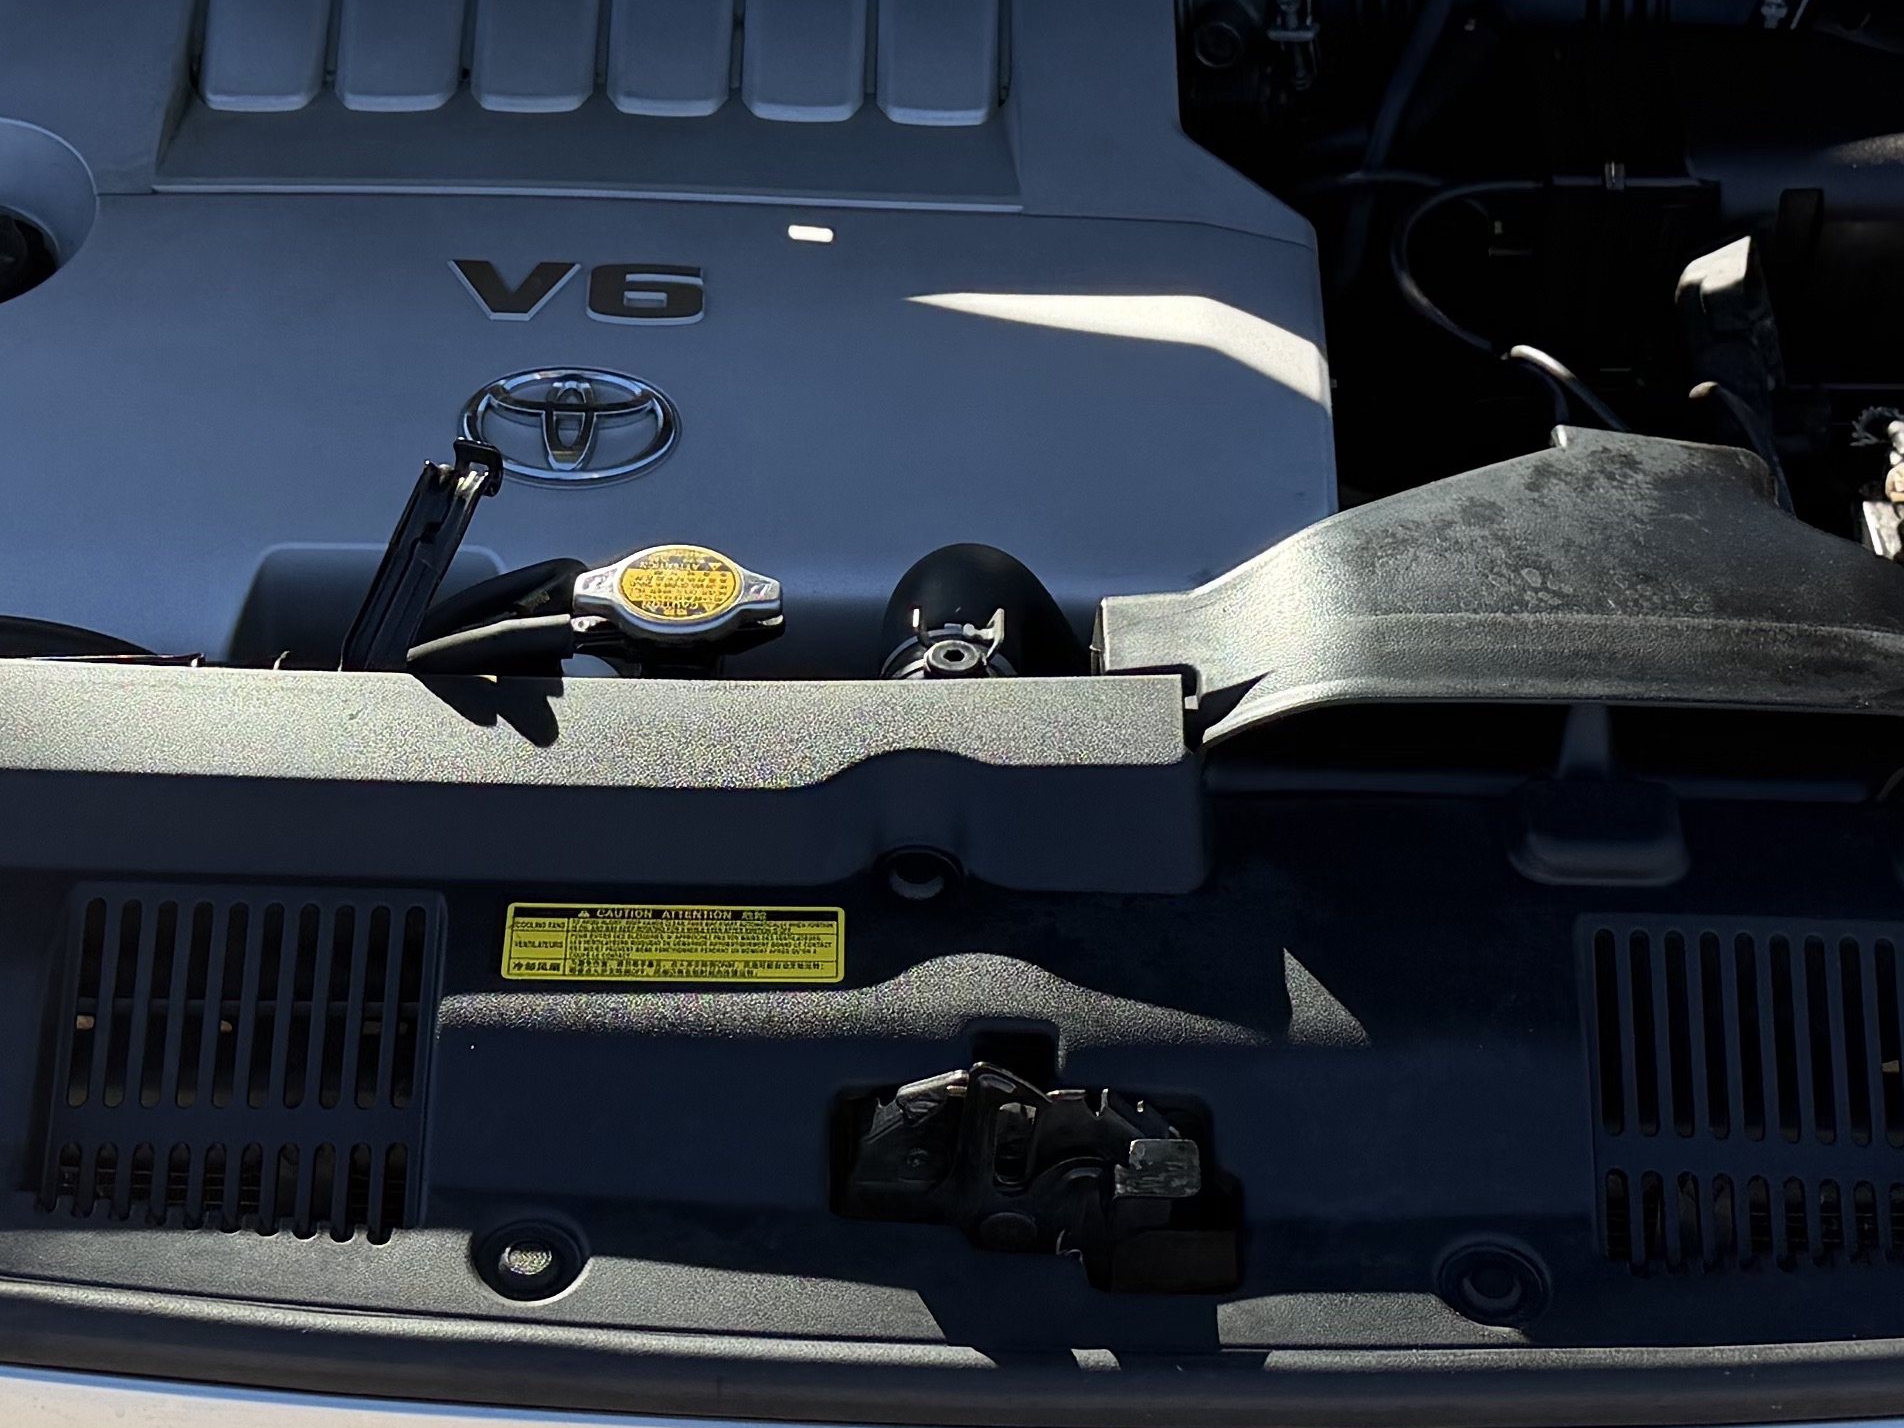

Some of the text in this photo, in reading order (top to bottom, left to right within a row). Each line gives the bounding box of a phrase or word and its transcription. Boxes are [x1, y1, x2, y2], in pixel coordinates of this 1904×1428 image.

[447, 258, 706, 326] V6
[596, 908, 732, 920] CAUTION ATTENTION
